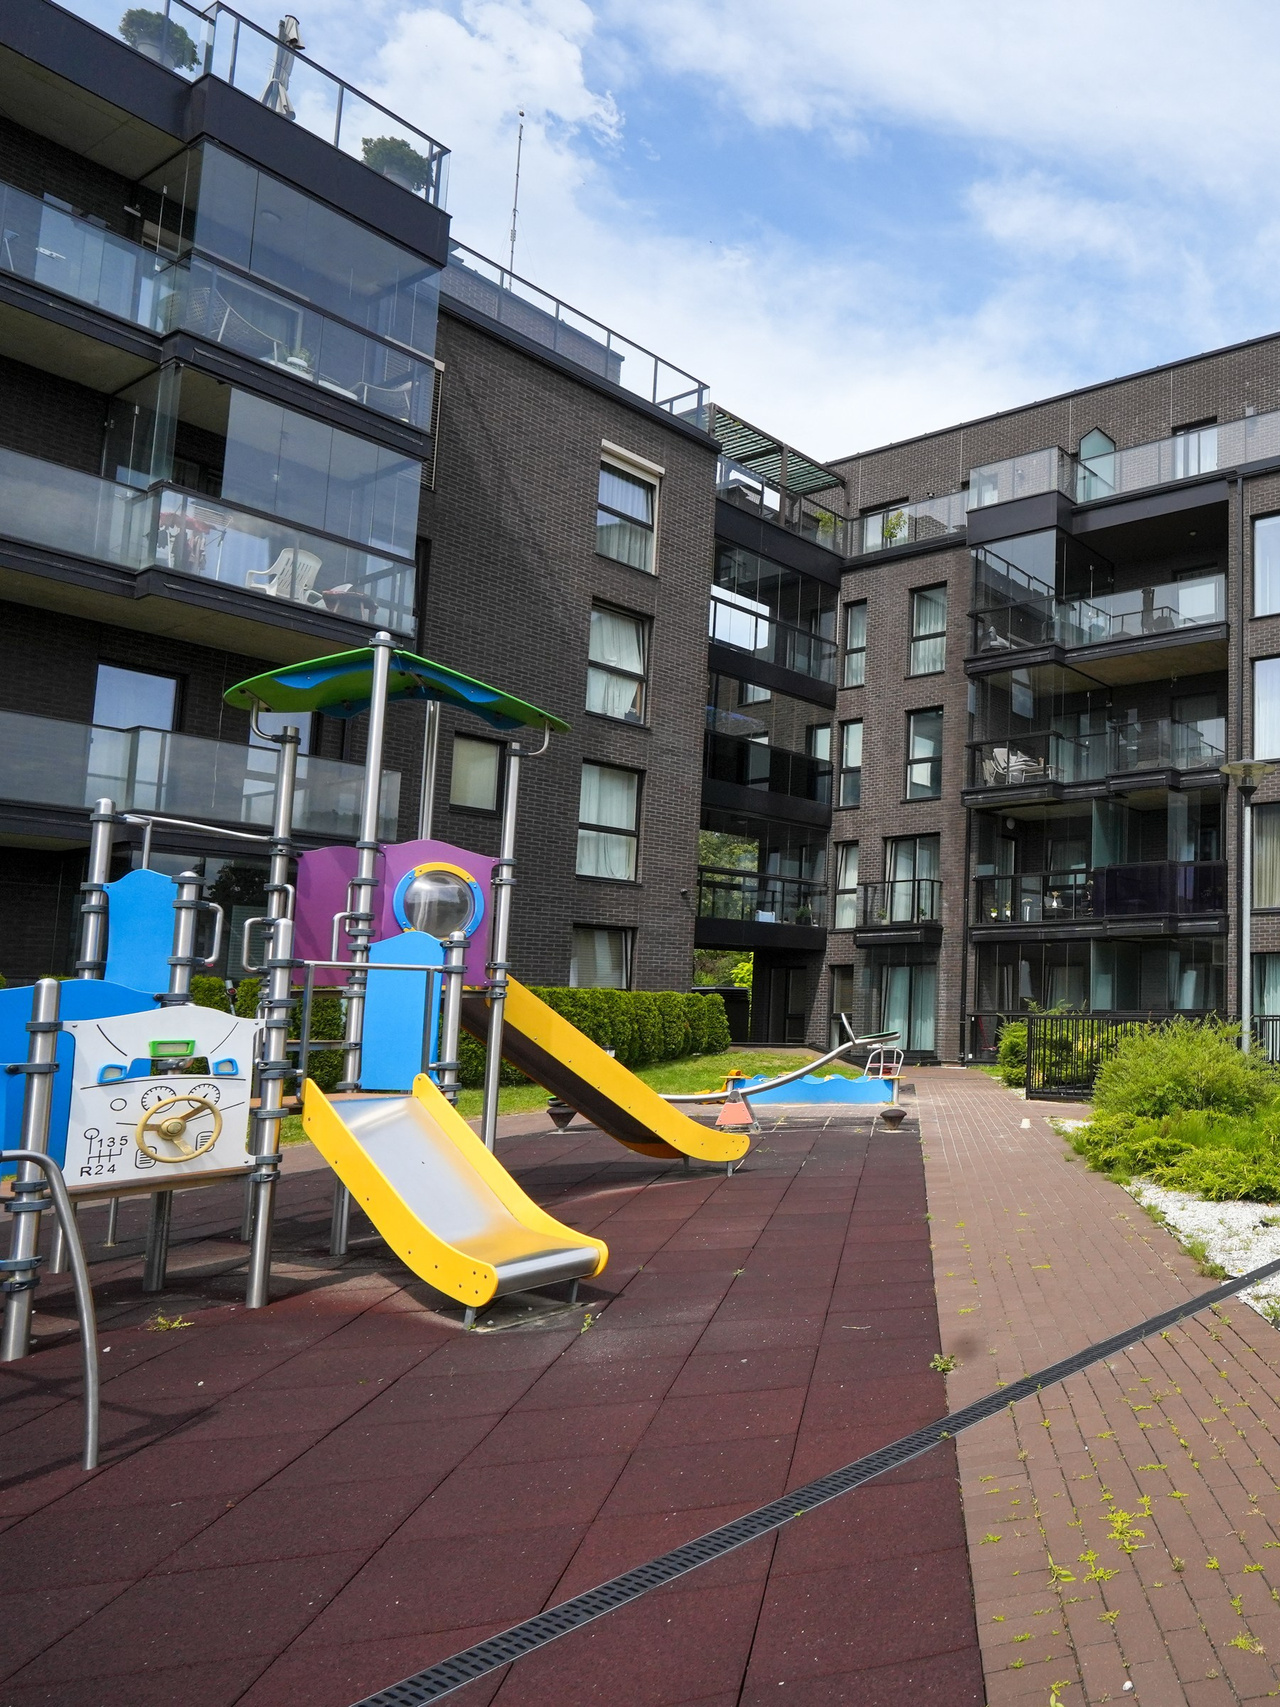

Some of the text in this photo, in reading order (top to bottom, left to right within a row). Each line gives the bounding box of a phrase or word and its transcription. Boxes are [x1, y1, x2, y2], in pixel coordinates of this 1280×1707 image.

[98, 1135, 128, 1148] 1 3 5
[80, 1164, 116, 1177] R 2 4
